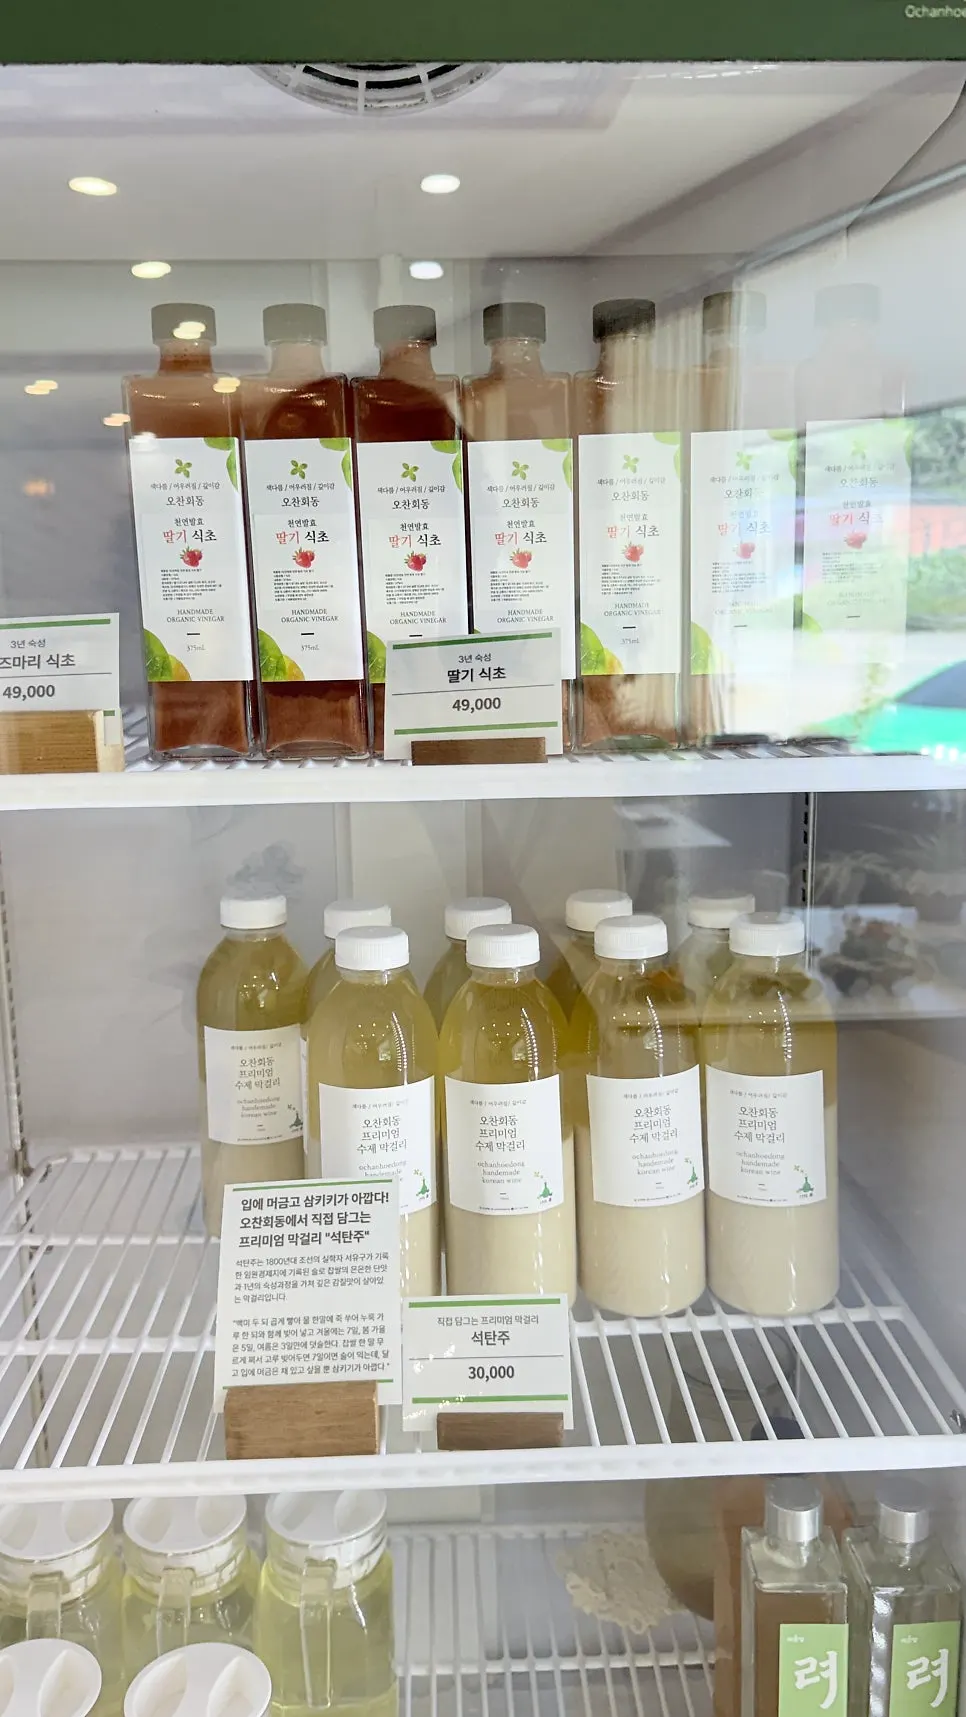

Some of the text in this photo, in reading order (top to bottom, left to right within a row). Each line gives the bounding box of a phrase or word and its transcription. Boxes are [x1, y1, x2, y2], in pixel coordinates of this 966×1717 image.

[166, 495, 205, 508] 오찬회동
[281, 496, 320, 508] 오찬회동
[393, 498, 430, 510] 오찬회동
[502, 497, 540, 509] 오찬회동
[174, 517, 204, 527] 천연발효
[288, 519, 317, 528] 천연발효
[400, 522, 429, 532] 천연발효
[506, 519, 535, 529] 천연발효
[163, 529, 217, 543] 딸기 식초
[276, 530, 329, 544] 딸기 식초
[607, 523, 660, 539] 딸기 식초
[389, 533, 442, 548] 딸기 식초
[495, 531, 547, 545] 딸기 식초
[389, 616, 447, 625] ORGANIC VINEGAR
[497, 616, 525, 624] ORGANIC
[10, 639, 46, 649] 3년 숙성
[46, 653, 76, 669] 식초
[458, 653, 492, 664] 3년 숙성
[447, 666, 507, 683] 딸기 식초
[2, 685, 55, 701] 49,000
[452, 697, 501, 713] 49,000
[240, 1057, 275, 1068] 오찬회동
[239, 1068, 274, 1078] 프리미엄
[235, 1077, 281, 1090] 수제 막걸리
[634, 1105, 671, 1118] 오찬회동
[739, 1106, 778, 1118] 오찬회동
[363, 1116, 400, 1129] 오찬회동
[480, 1115, 518, 1126] 오찬회동
[634, 1118, 671, 1130] 프리미엄
[739, 1119, 777, 1131] 프리미엄
[361, 1129, 400, 1141] 프리미엄
[479, 1128, 517, 1139] 프리미엄
[629, 1128, 678, 1143] 수제 막걸리
[734, 1131, 785, 1143] 수제 막걸리
[357, 1139, 407, 1155] 수제 막걸리
[475, 1140, 525, 1152] 수제 막걸리
[241, 1191, 389, 1211] 입에 머금고 삼키키가 아깝다!
[240, 1211, 371, 1229] 오찬회동에서 직접 담그는
[238, 1230, 370, 1248] 프리미엄 막걸리 "석탄주"
[437, 1314, 539, 1327] 직접 담그는 프리미엄 막걸리
[471, 1330, 510, 1346] 석탄주
[468, 1365, 515, 1382] 30,000
[794, 1650, 837, 1709] 려
[906, 1648, 949, 1708] 려
